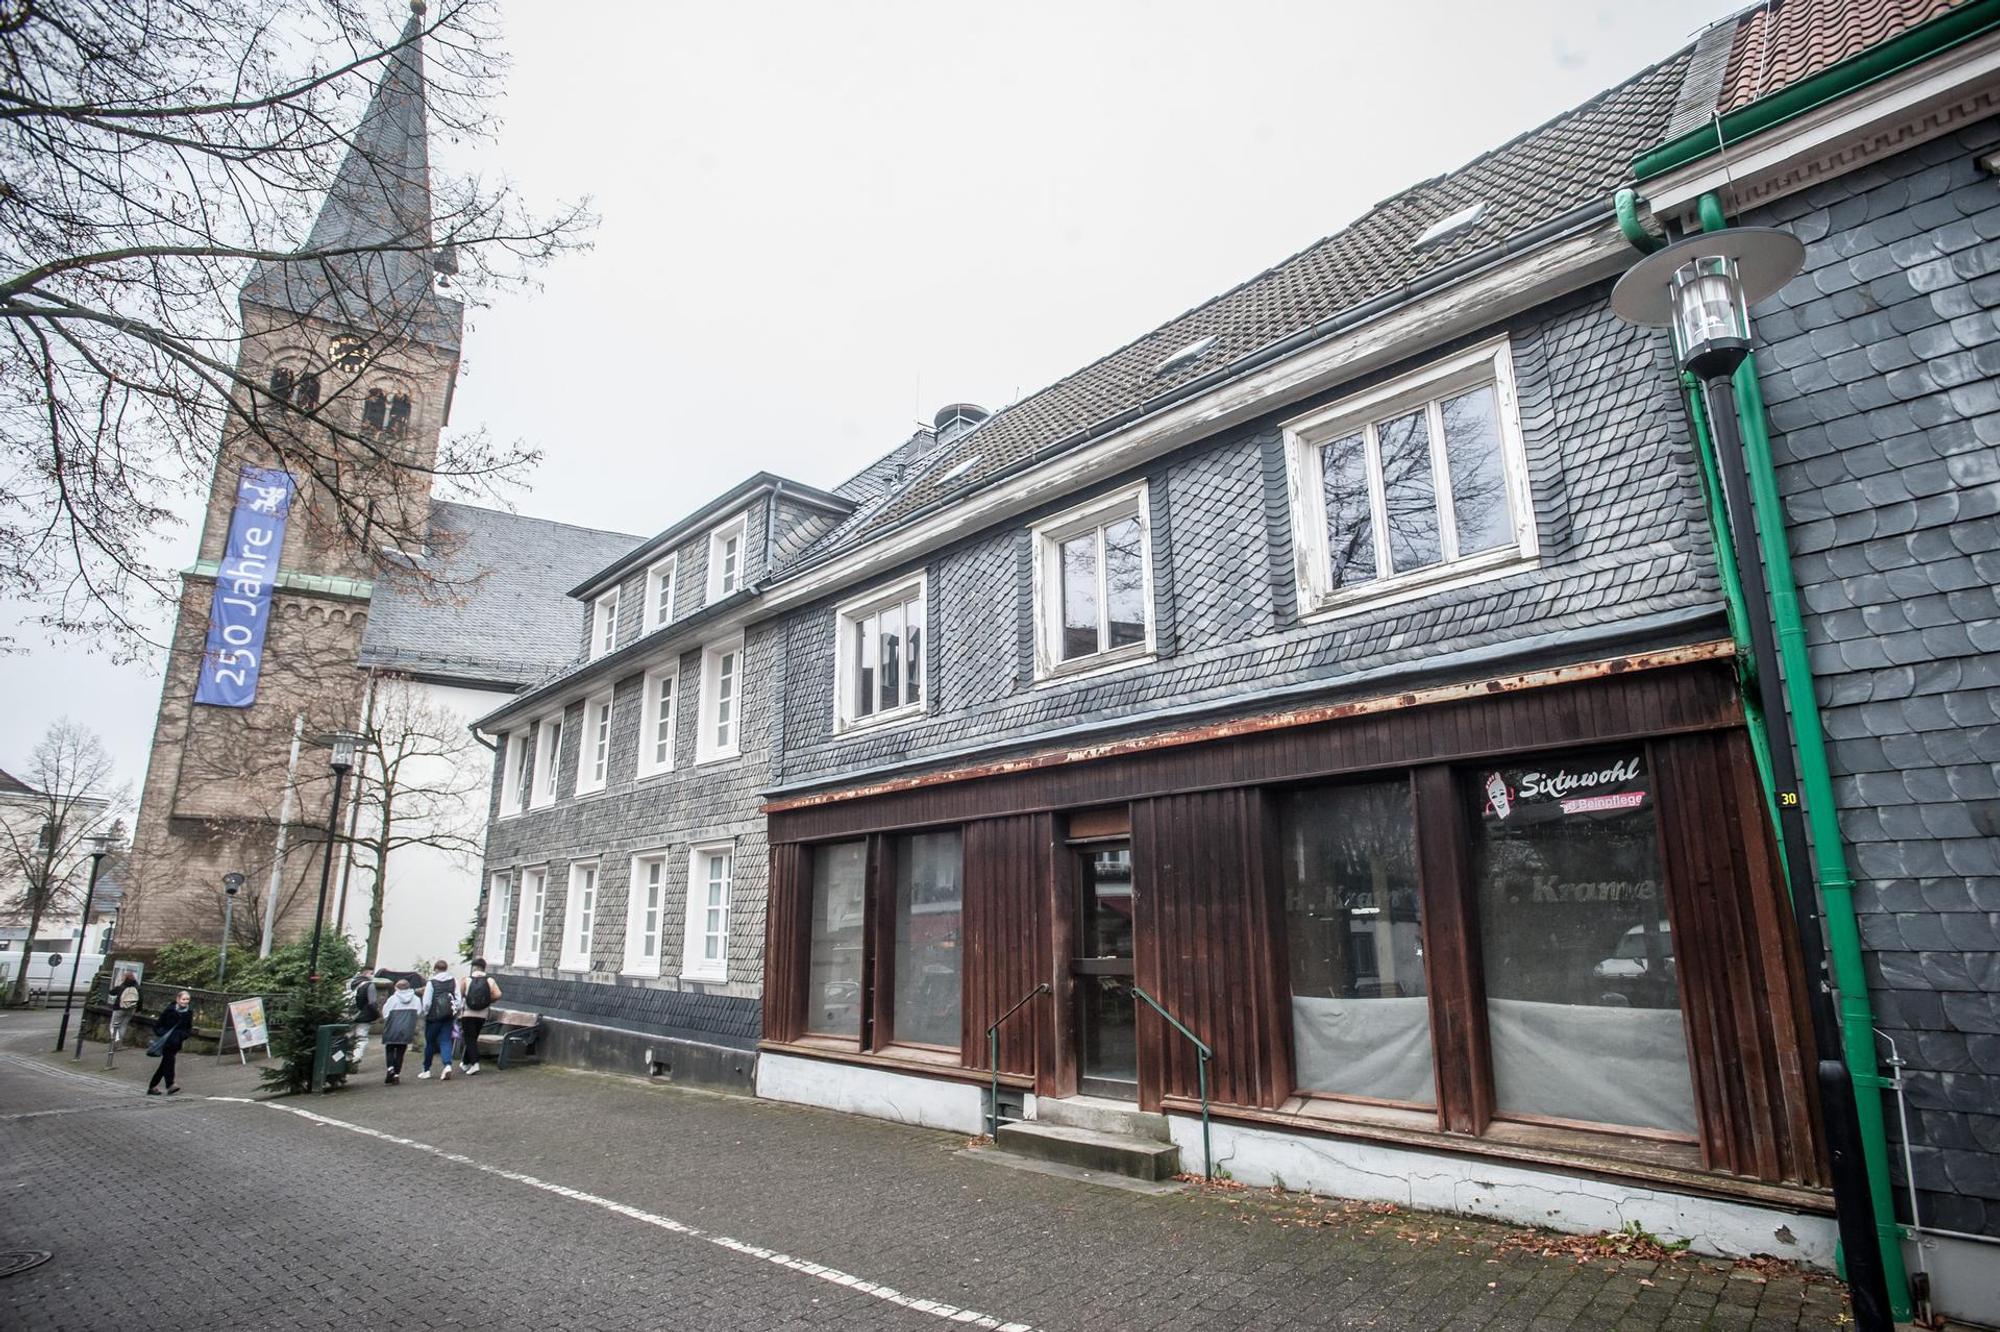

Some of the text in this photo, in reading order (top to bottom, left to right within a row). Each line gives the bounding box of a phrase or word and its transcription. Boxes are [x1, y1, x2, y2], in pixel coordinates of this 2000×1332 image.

[215, 527, 273, 687] 250 Jahre
[1519, 757, 1640, 798] Sixtuwohl
[1781, 793, 1798, 805] 30
